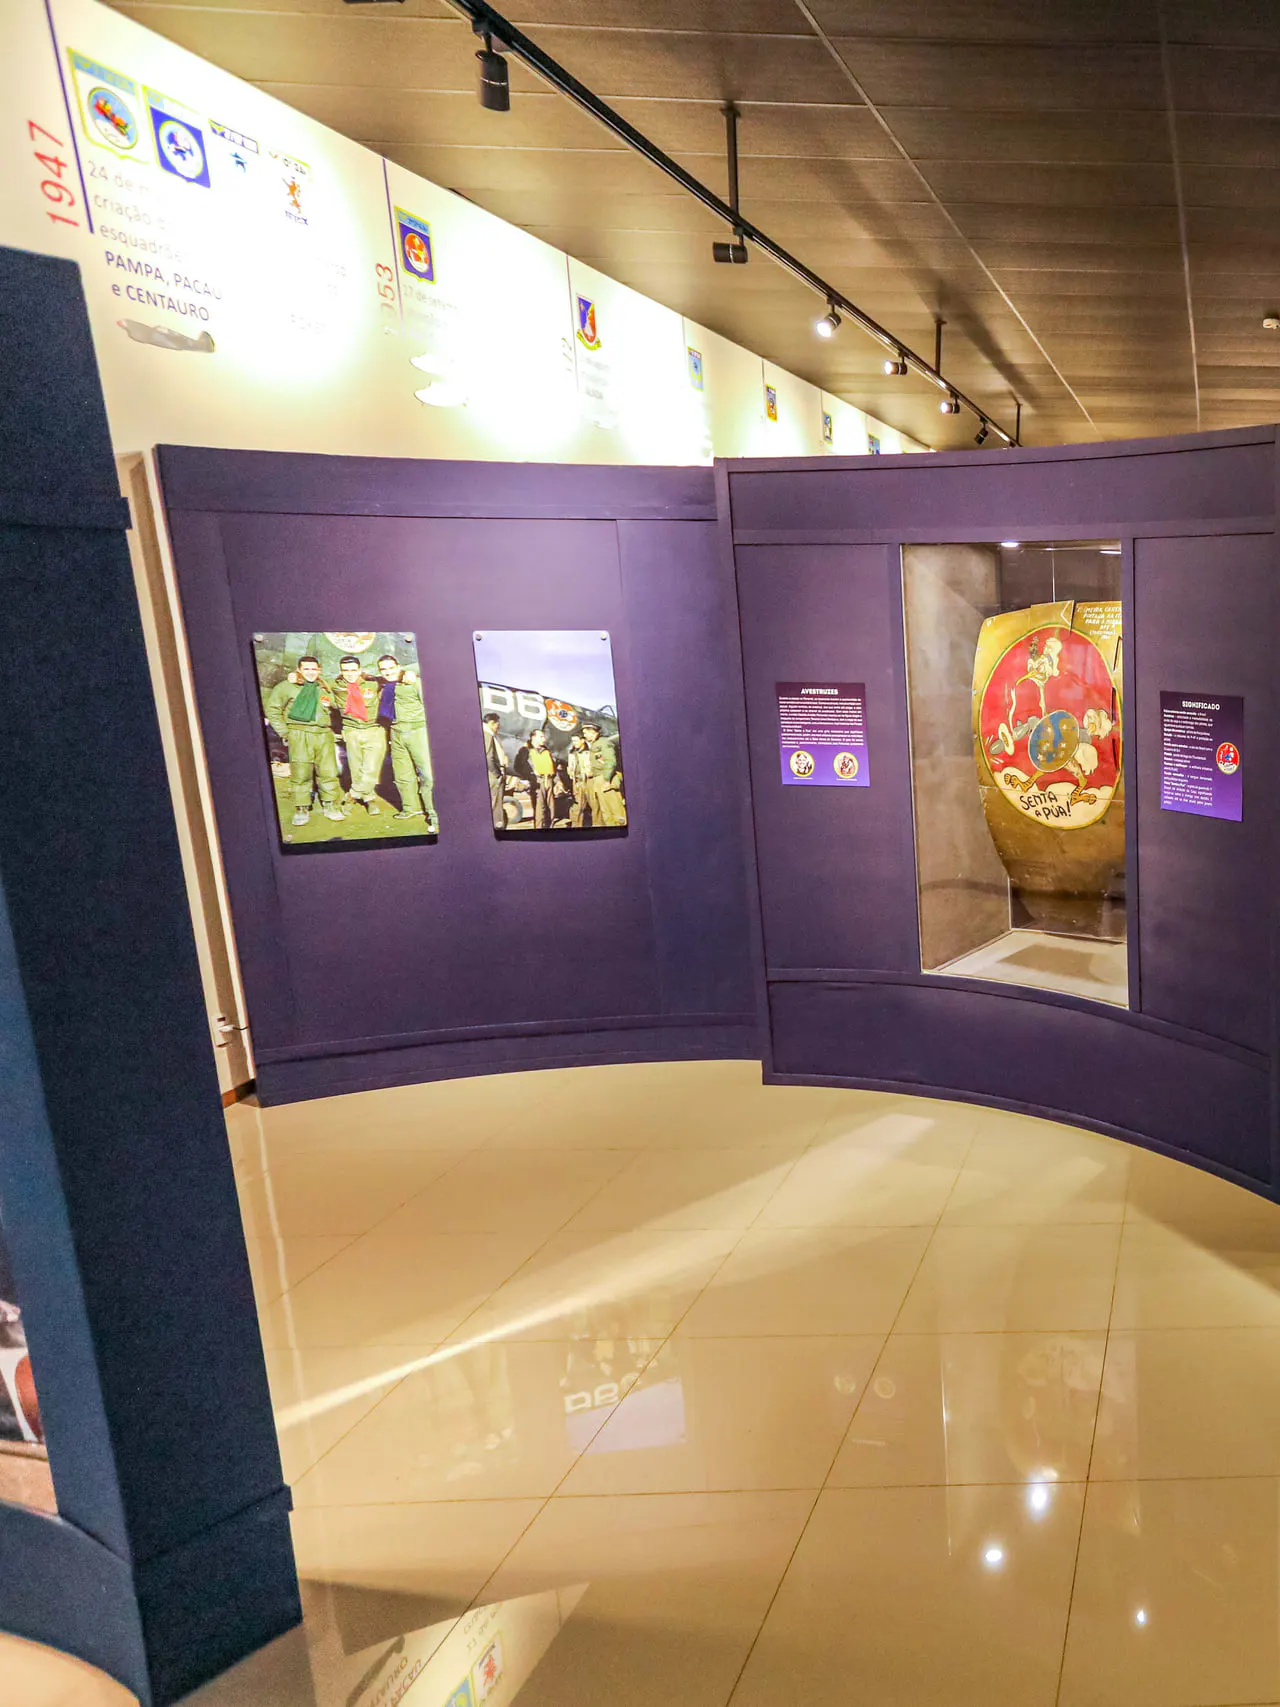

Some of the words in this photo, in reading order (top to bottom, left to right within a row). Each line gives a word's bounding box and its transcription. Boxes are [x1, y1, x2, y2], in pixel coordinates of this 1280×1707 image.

[27, 119, 80, 228] 1947
[87, 159, 109, 182] 24
[104, 250, 171, 287] PAMPA,
[110, 283, 122, 297] e
[125, 284, 210, 322] CENTAURO
[1181, 700, 1221, 711] SIGNIFICADO
[1019, 791, 1058, 811] SENTA
